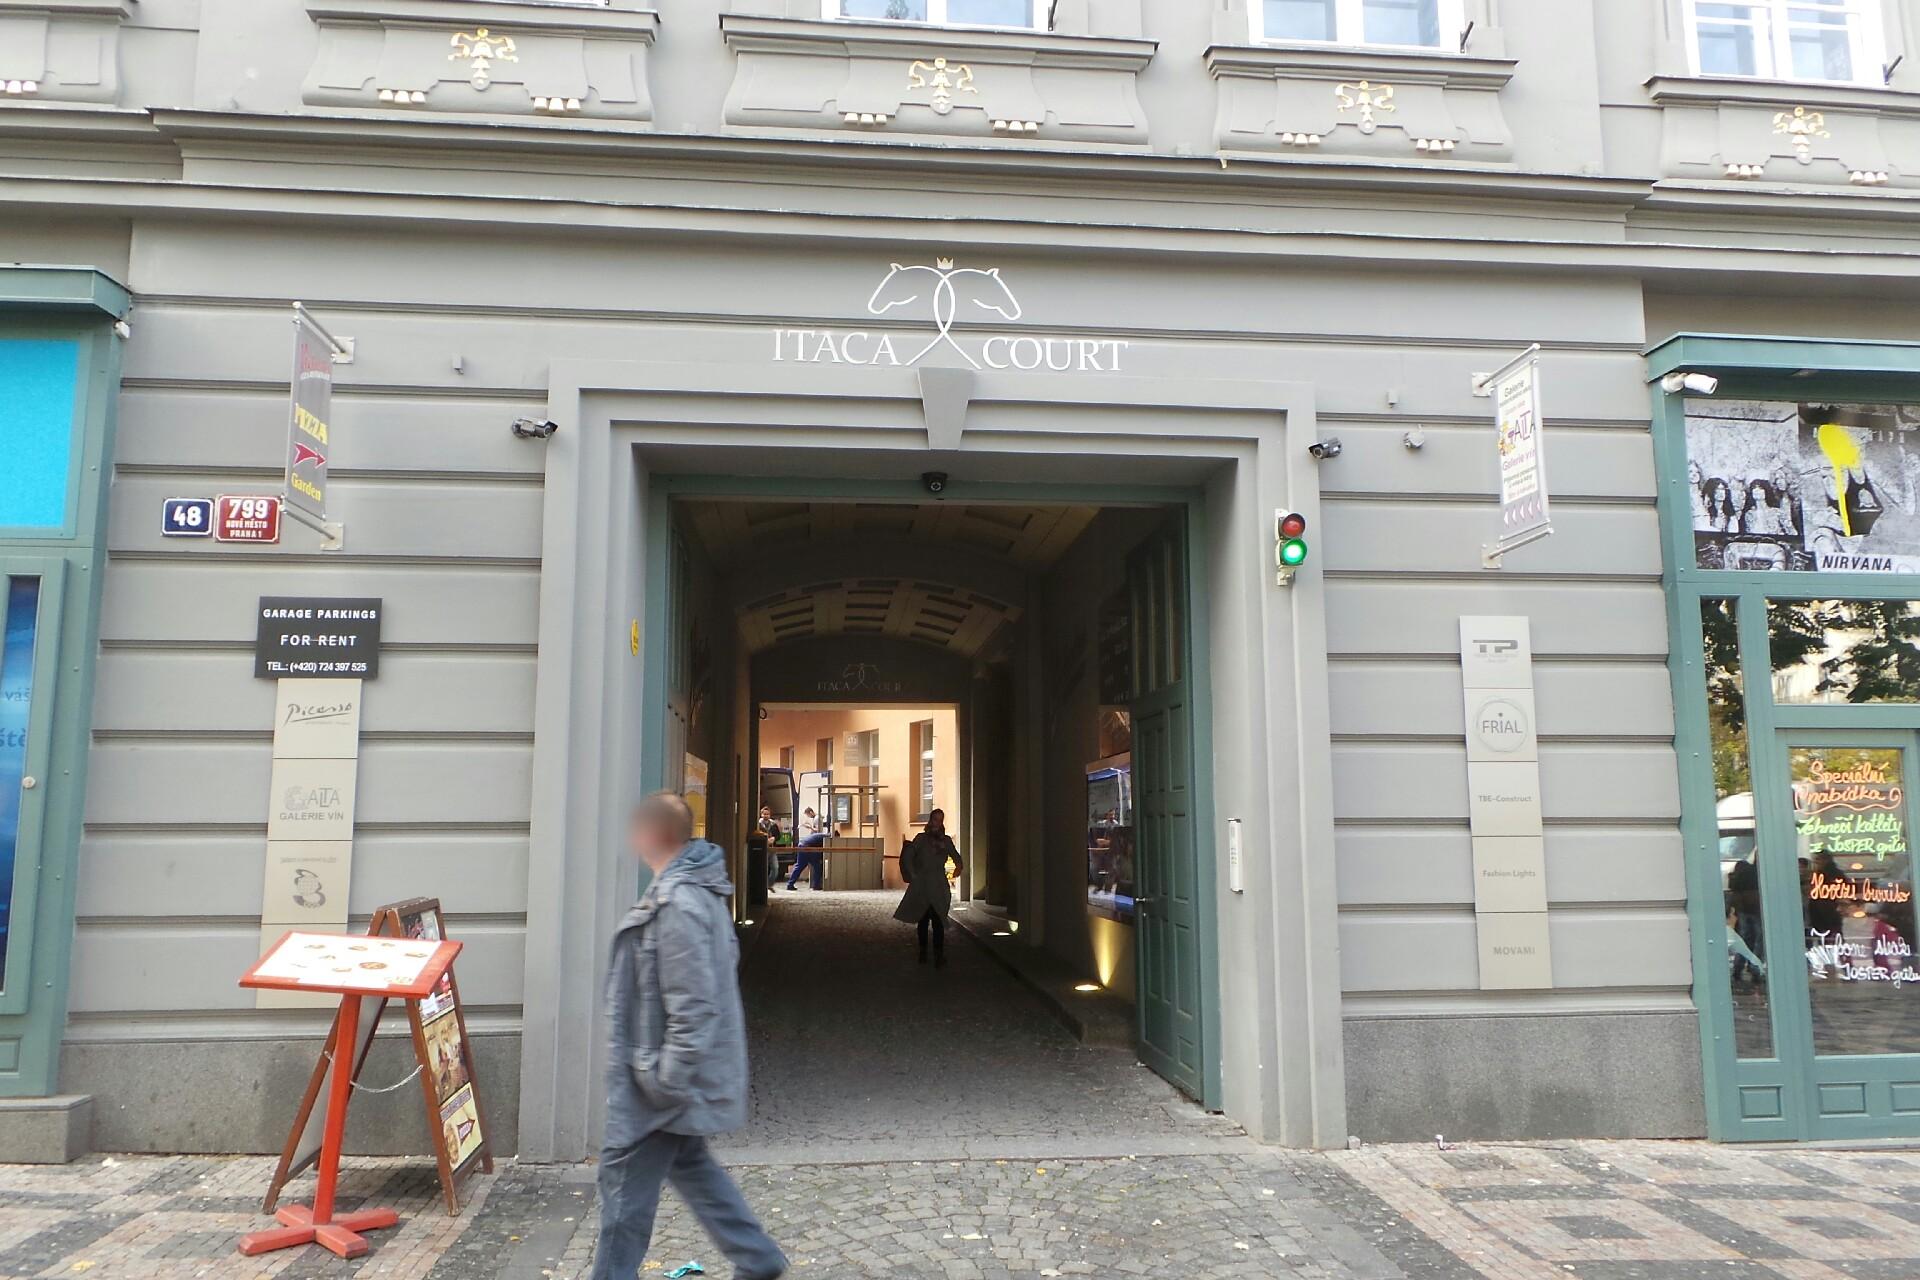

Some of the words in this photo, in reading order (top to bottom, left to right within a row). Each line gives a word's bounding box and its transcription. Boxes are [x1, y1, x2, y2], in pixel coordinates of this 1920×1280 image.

[771, 328, 902, 366] ITACA
[982, 336, 1129, 371] COURT
[294, 402, 329, 446] PIZZA
[291, 472, 321, 501] Garden
[172, 505, 202, 527] 48
[229, 499, 269, 519] 799
[229, 529, 257, 538] PRAHA
[257, 530, 262, 538] 1
[1822, 555, 1893, 571] NIRVANA
[262, 608, 312, 619] GARAGE
[317, 609, 376, 620] PARKINGS
[280, 634, 311, 646] FOR
[318, 635, 357, 647] RENT
[289, 661, 317, 673] (+420)
[319, 662, 334, 672] 724
[334, 662, 350, 672] 397
[351, 662, 367, 672] 525
[1808, 760, 1890, 790] Speciální
[1808, 785, 1886, 805] nabídka
[279, 812, 325, 821] GALERIE
[1855, 813, 1902, 842] kotlety
[1481, 869, 1512, 878] Fashion
[1513, 869, 1537, 879] Lights
[1493, 946, 1537, 956] MOVAMI
